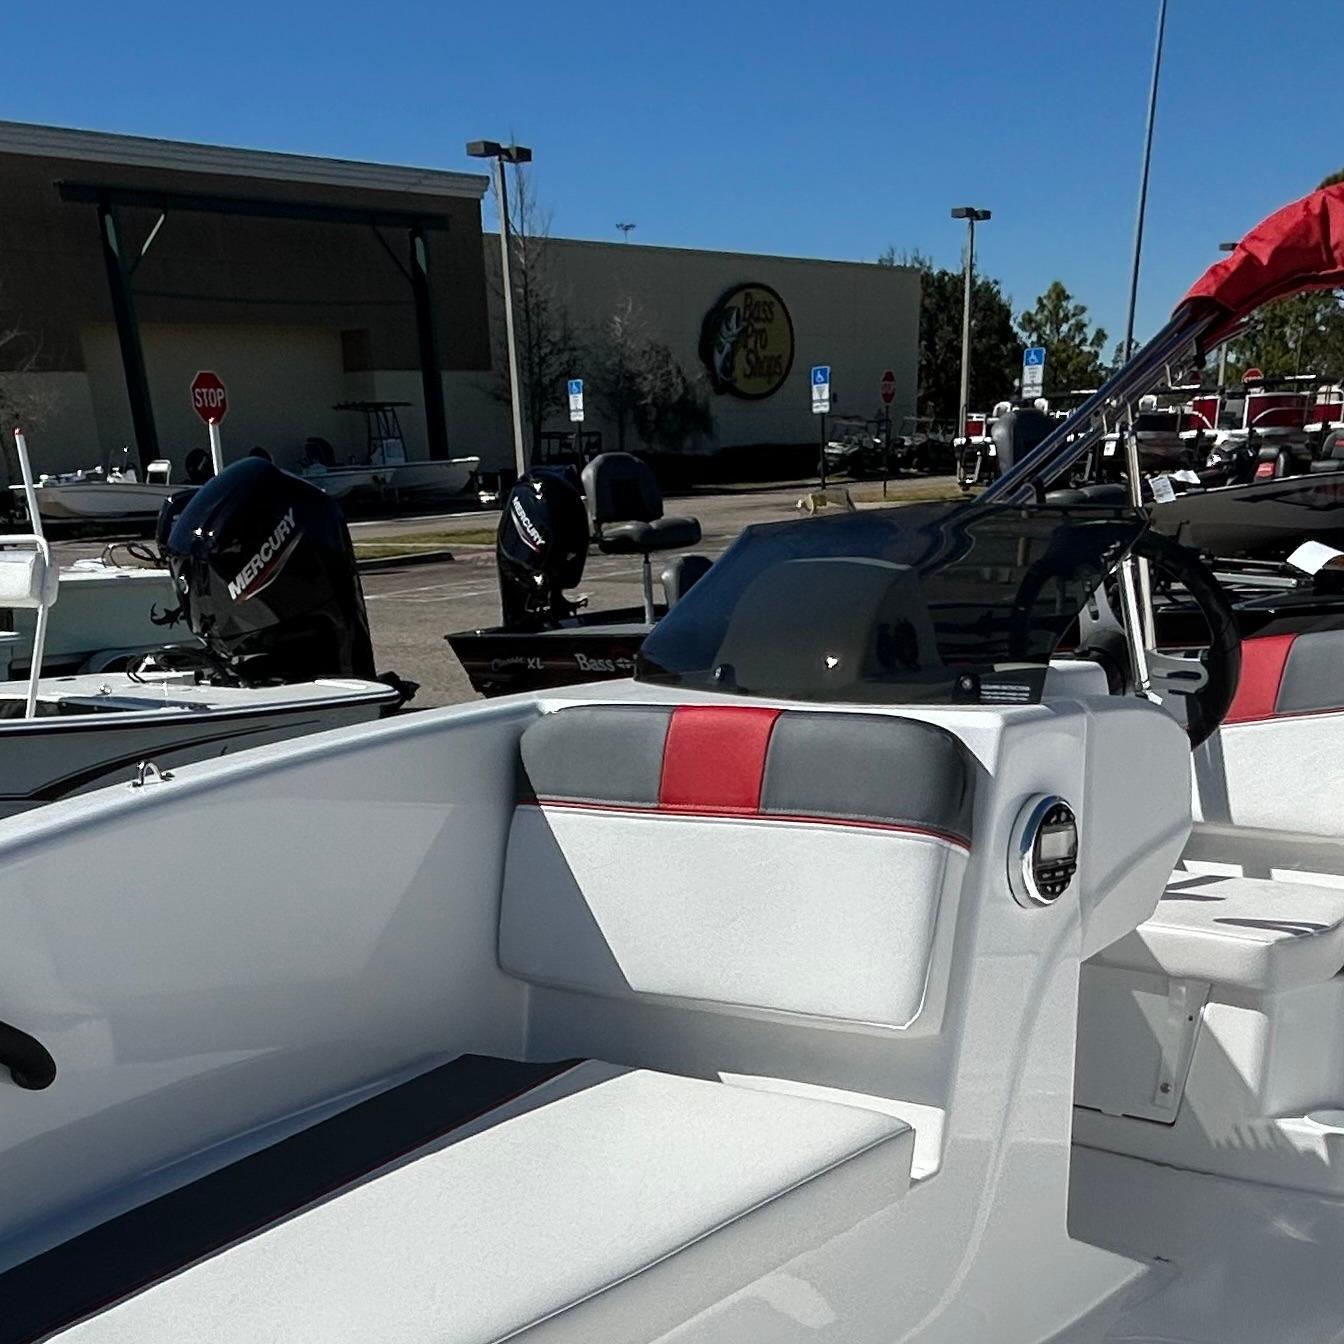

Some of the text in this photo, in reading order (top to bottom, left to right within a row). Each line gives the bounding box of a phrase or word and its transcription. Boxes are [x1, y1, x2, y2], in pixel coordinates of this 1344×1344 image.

[742, 291, 775, 323] Bass
[743, 321, 768, 352] Pro
[743, 348, 785, 384] Shops
[194, 388, 225, 408] STOP
[512, 496, 546, 546] MERCURY
[227, 507, 296, 600] MERCURY
[527, 657, 545, 670] XL
[574, 653, 616, 672] Bass
